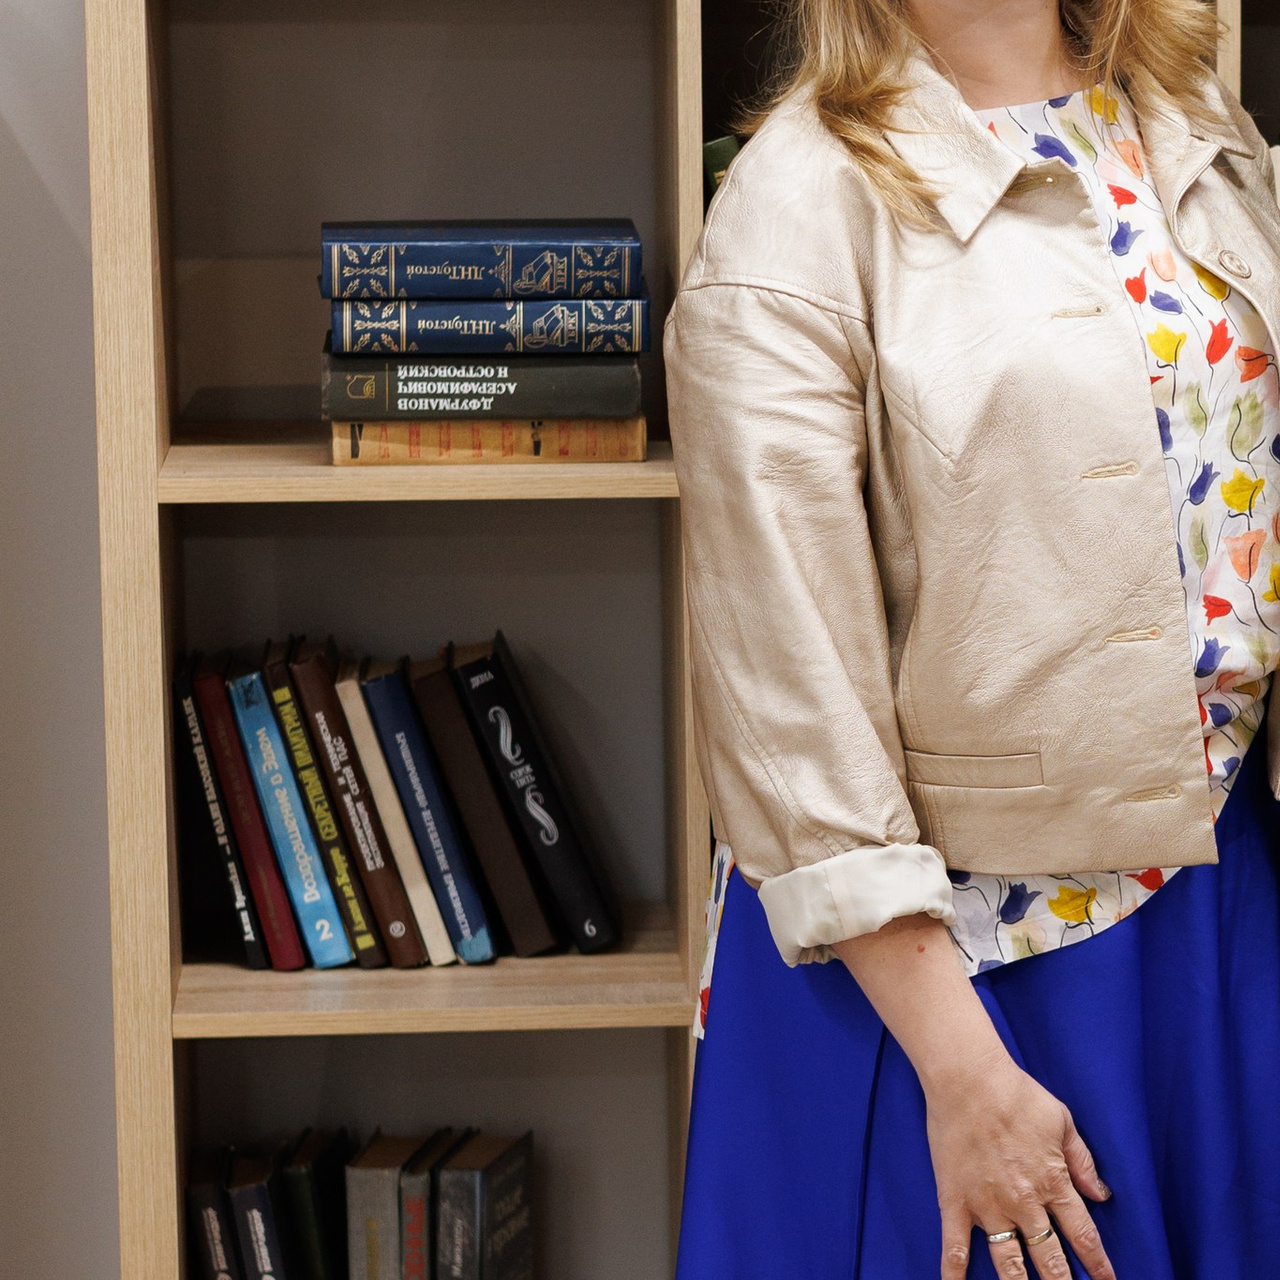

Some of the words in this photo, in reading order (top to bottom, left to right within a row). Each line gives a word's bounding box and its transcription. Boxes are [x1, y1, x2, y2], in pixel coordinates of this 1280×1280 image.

[406, 264, 486, 281] Л.Н.Толстой
[417, 315, 497, 335] Л.Н.Толстой
[397, 381, 518, 396] А.СЕРАФИМОВИЧ
[397, 397, 494, 412] Д.ФУРМАНОВ
[332, 734, 350, 762] ПДС
[298, 764, 339, 843] СЕКРЕТНЫЙ
[313, 917, 334, 943] 2
[585, 919, 597, 937] 6
